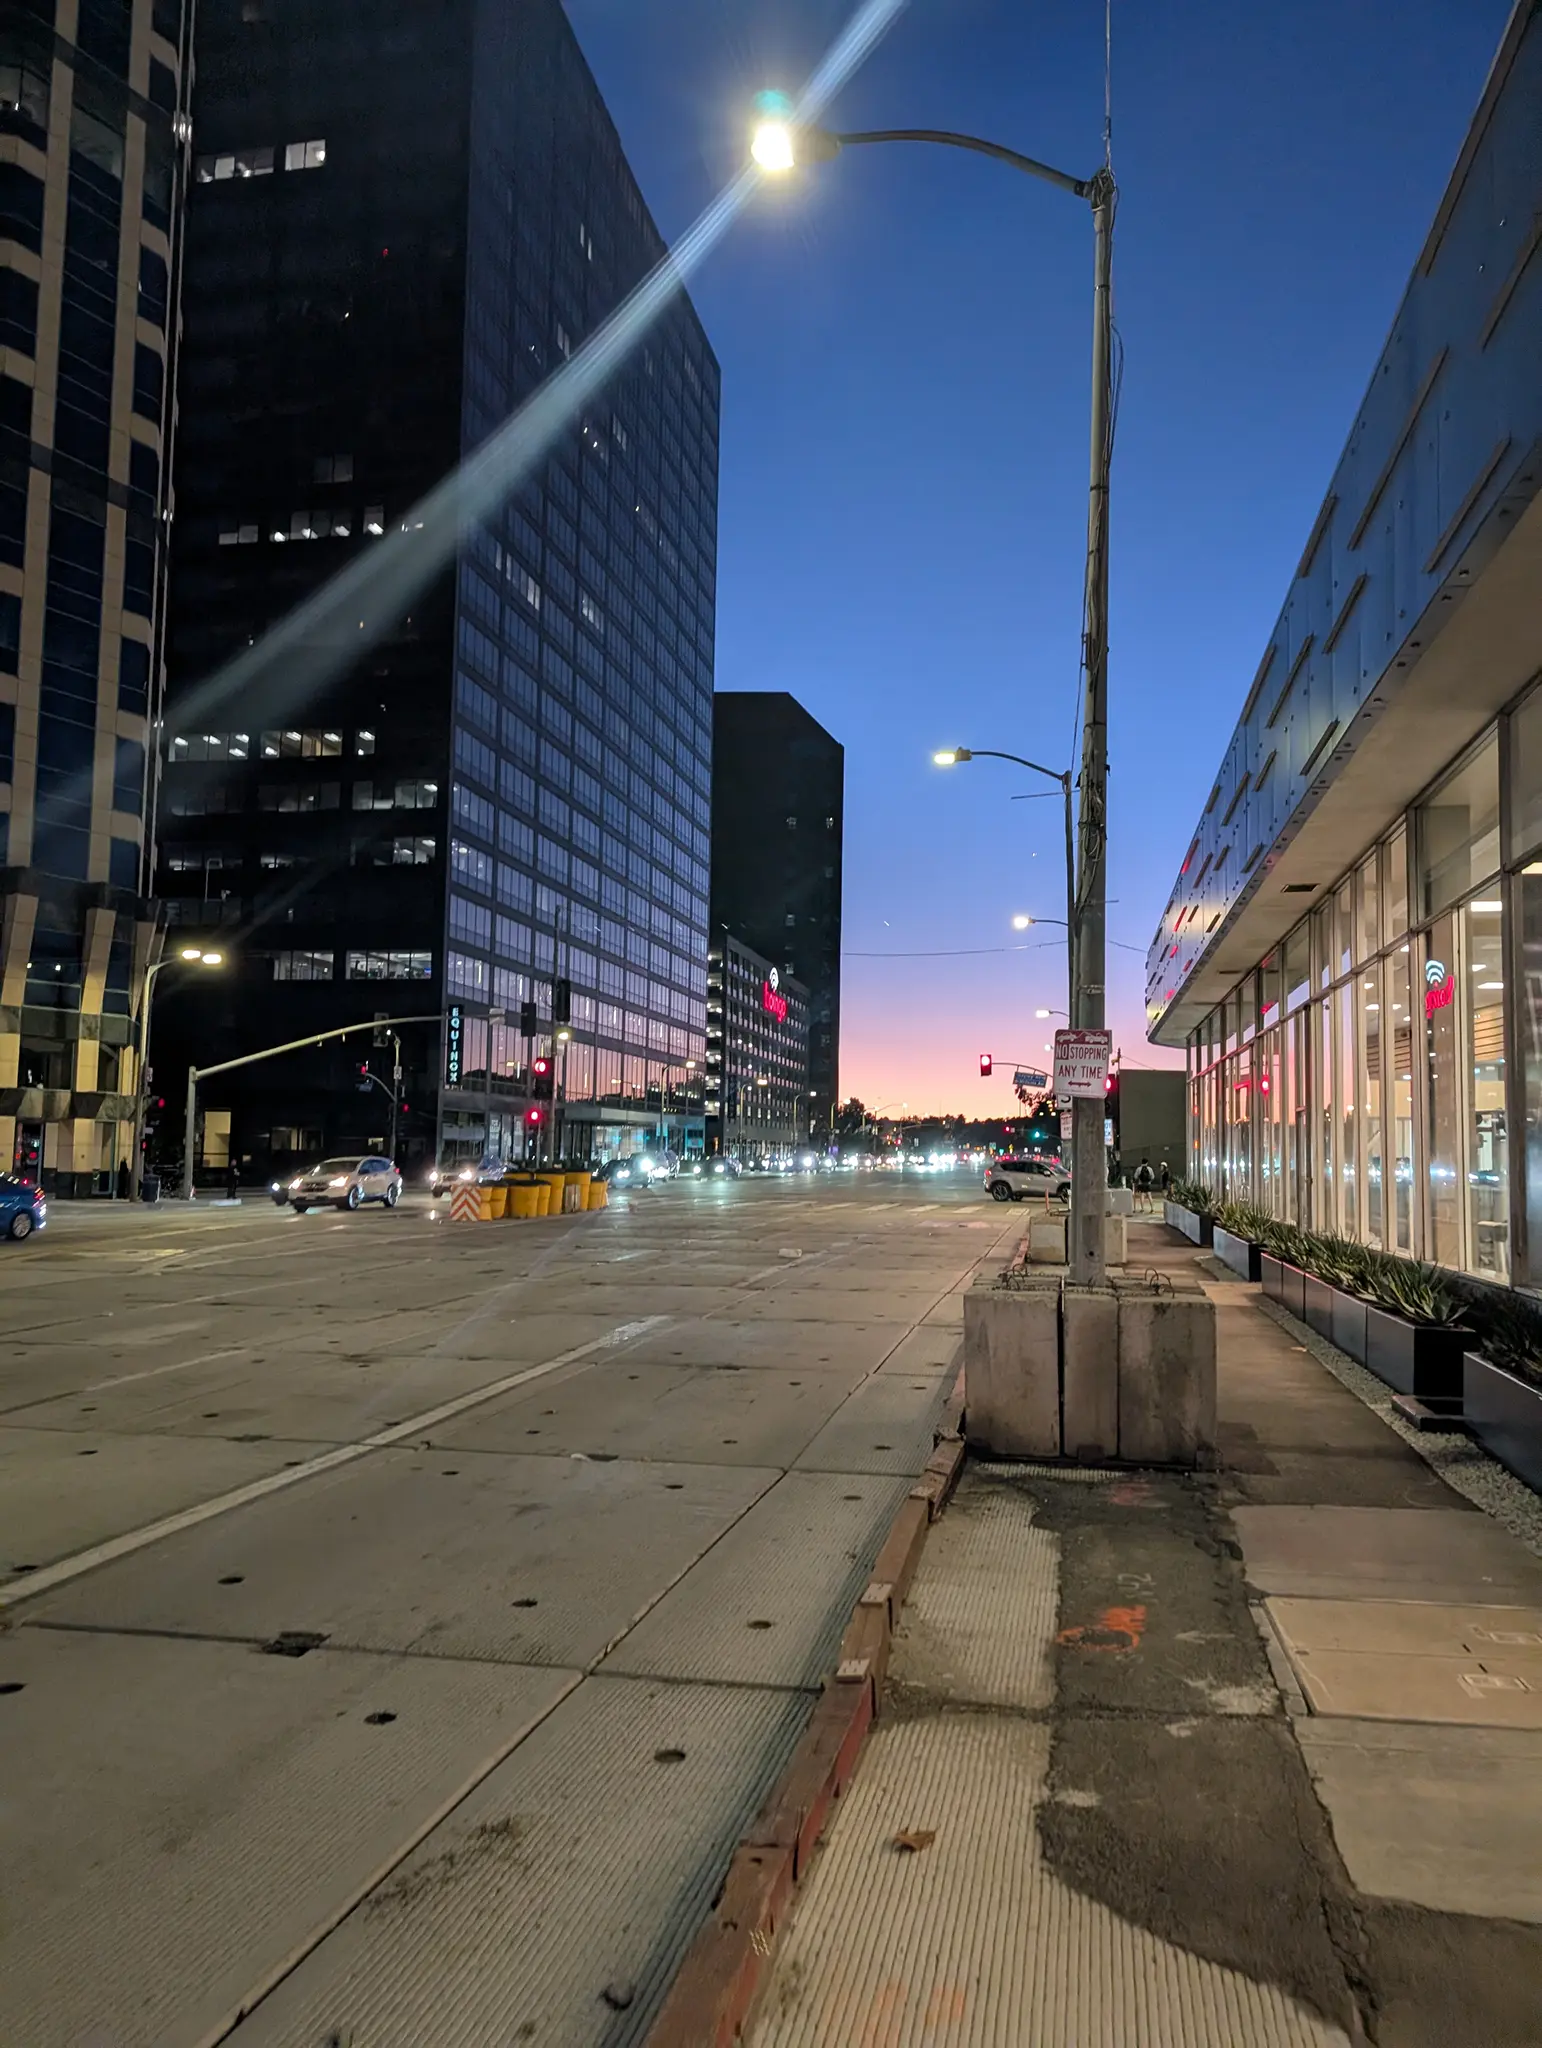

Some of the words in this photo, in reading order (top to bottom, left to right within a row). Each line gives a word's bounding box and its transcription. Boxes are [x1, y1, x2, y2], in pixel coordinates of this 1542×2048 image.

[449, 1007, 460, 1082] EQUINOX
[1056, 1044, 1069, 1060] NO
[1069, 1045, 1107, 1061] STOPPING
[1058, 1064, 1077, 1078] ANY
[1080, 1065, 1103, 1079] TIME
